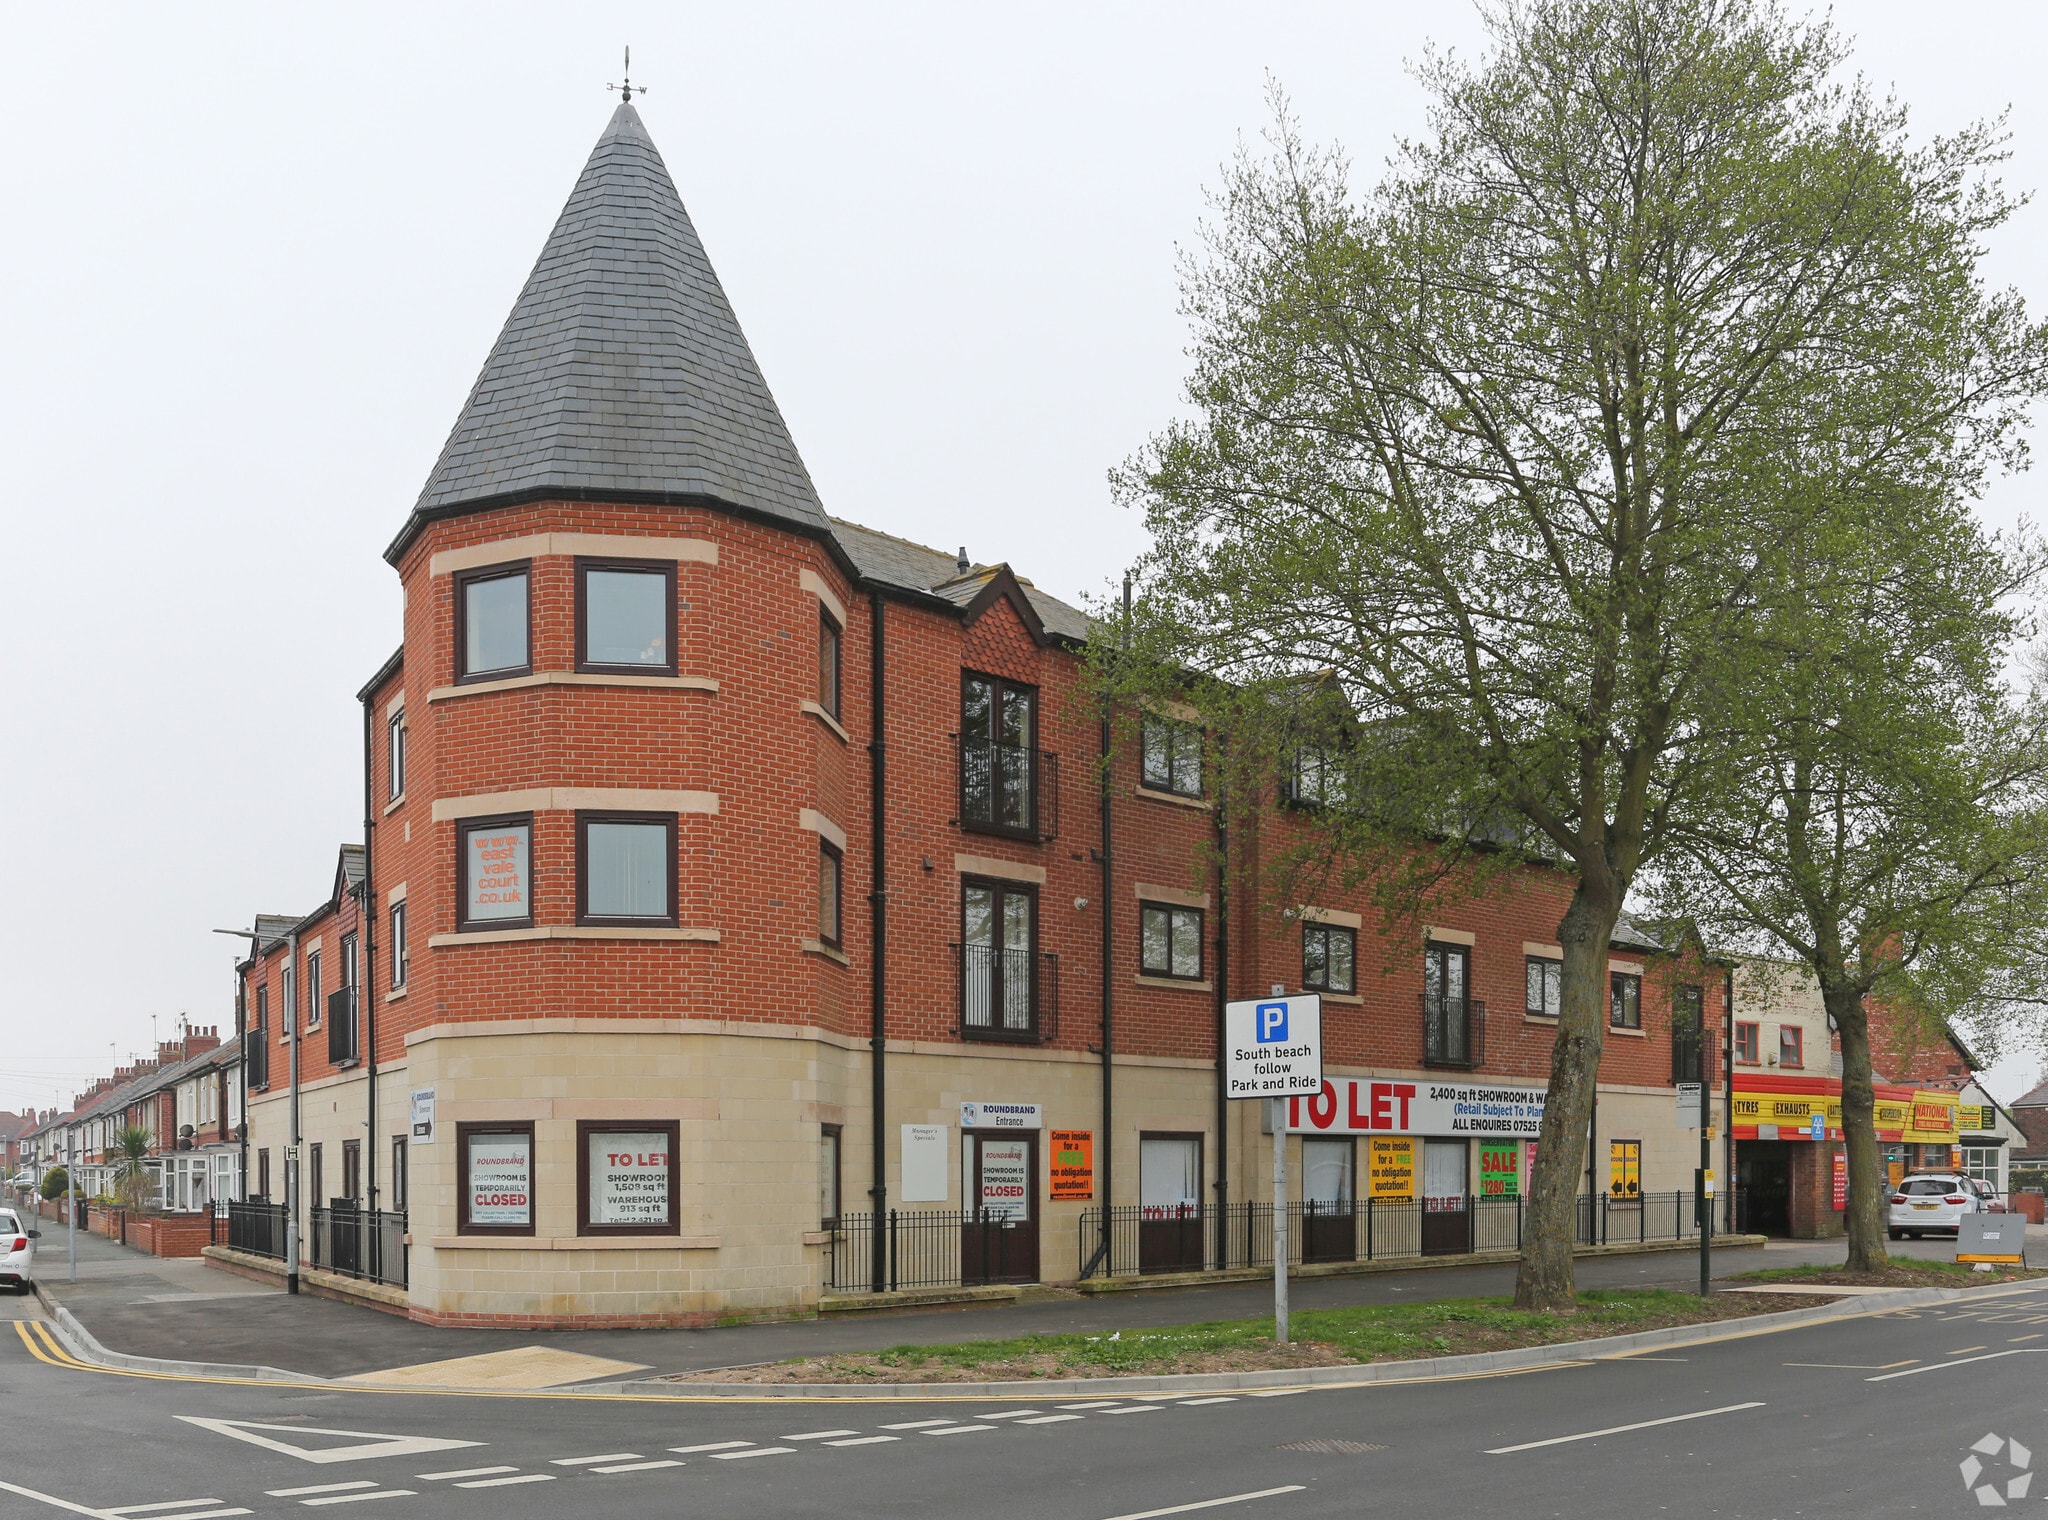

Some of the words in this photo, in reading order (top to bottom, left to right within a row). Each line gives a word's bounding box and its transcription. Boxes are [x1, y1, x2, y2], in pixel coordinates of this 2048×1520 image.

[474, 835, 524, 849] www.
[481, 845, 515, 861] east
[482, 860, 515, 875] vale
[478, 874, 519, 889] court
[474, 889, 522, 904] .co.uk
[1263, 1007, 1284, 1039] P
[1235, 1047, 1271, 1061] South
[1275, 1044, 1311, 1058] beach
[1254, 1062, 1291, 1075] follow
[1232, 1079, 1258, 1091] Park
[1262, 1077, 1284, 1090] and
[1289, 1076, 1317, 1088] Ride
[1430, 1087, 1456, 1101] 2,400
[1457, 1090, 1468, 1102] sq
[1469, 1089, 1477, 1100] ft
[1477, 1090, 1528, 1103] SHOWROOM
[1529, 1093, 1535, 1104] &
[983, 1105, 1036, 1114] ROUNDBRAND
[1348, 1082, 1416, 1130] LET
[1454, 1103, 1481, 1115] (Retail
[1483, 1104, 1513, 1118] Subject
[1514, 1106, 1524, 1117] To
[1737, 1101, 1759, 1113] TYRES
[1775, 1102, 1810, 1115] EXHAUSTS
[1916, 1105, 1948, 1119] NATIONAL
[996, 1116, 1024, 1126] Entrance
[1452, 1118, 1469, 1130] ALL
[1470, 1119, 1512, 1131] ENQUIRES
[1513, 1120, 1537, 1132] 07525
[1052, 1131, 1070, 1140] Come
[1071, 1131, 1090, 1141] inside
[1064, 1141, 1073, 1150] for
[1373, 1141, 1391, 1151] Come
[1392, 1141, 1410, 1151] inside
[607, 1153, 633, 1167] TO
[1057, 1151, 1085, 1165] FREE
[1378, 1154, 1387, 1164] for
[1388, 1156, 1393, 1164] a
[1396, 1154, 1411, 1164] FREE
[1481, 1151, 1517, 1172] SALE
[474, 1174, 518, 1182] SHOWROOM
[519, 1174, 527, 1182] IS
[1051, 1169, 1059, 1177] no
[1061, 1167, 1092, 1178] obligation
[1372, 1169, 1380, 1177] no
[1381, 1167, 1411, 1179] obligation
[614, 1184, 641, 1192] 1,508
[983, 1185, 1024, 1197] CLOSED
[1054, 1180, 1089, 1191] quotation!!
[1375, 1180, 1409, 1192] quotation!!
[475, 1193, 527, 1206] CLOSED
[652, 1204, 662, 1212] ft
